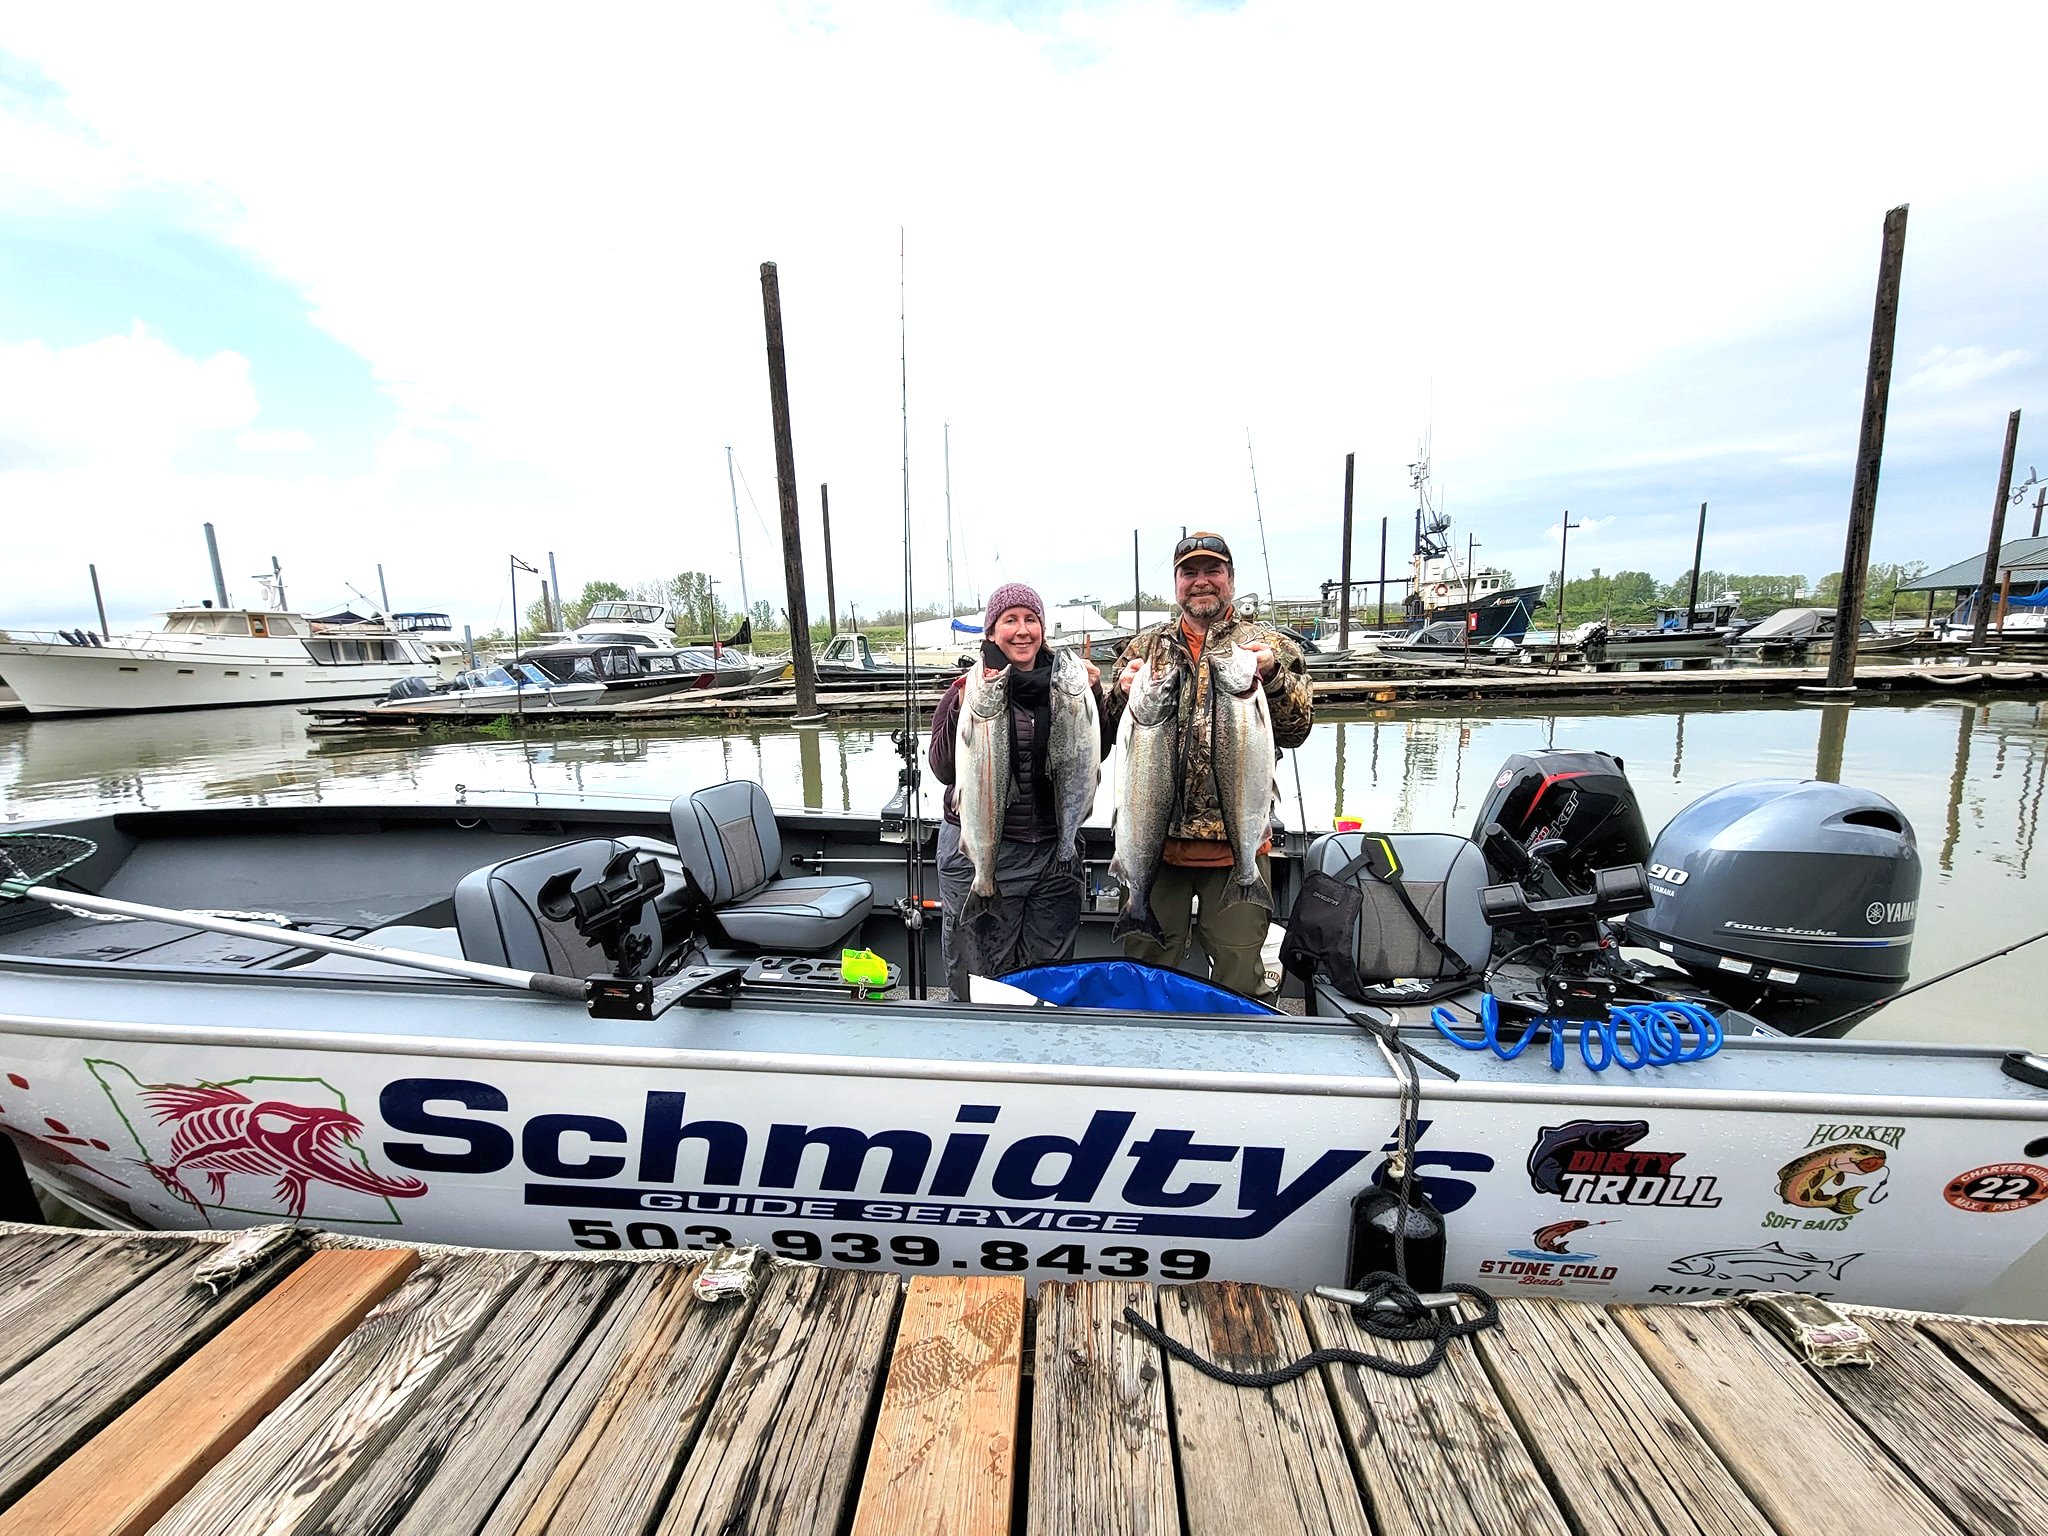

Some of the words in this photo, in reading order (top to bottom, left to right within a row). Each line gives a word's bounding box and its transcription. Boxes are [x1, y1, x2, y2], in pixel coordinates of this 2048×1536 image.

[1648, 864, 1689, 885] 90
[1653, 885, 1675, 897] YAMAHA
[1887, 901, 1916, 923] YAMA
[1803, 1124, 1906, 1150] HORKER
[379, 1078, 1495, 1240] Schmidty's
[1567, 1151, 1686, 1174] DIRTY
[1960, 1164, 2025, 1182] CHARTER
[1561, 1174, 1722, 1207] TROLL
[1969, 1177, 2029, 1199] 22
[640, 1193, 837, 1218] GUIDE
[861, 1203, 1143, 1232] SERVICE
[1992, 1200, 2029, 1211] PASS
[1761, 1210, 1802, 1229] SOFT
[1802, 1215, 1854, 1231] BAITS
[567, 1218, 1211, 1280] 503939.8439
[1479, 1260, 1554, 1276] STONE
[1559, 1264, 1618, 1280] COLD
[1518, 1275, 1565, 1287] Beads
